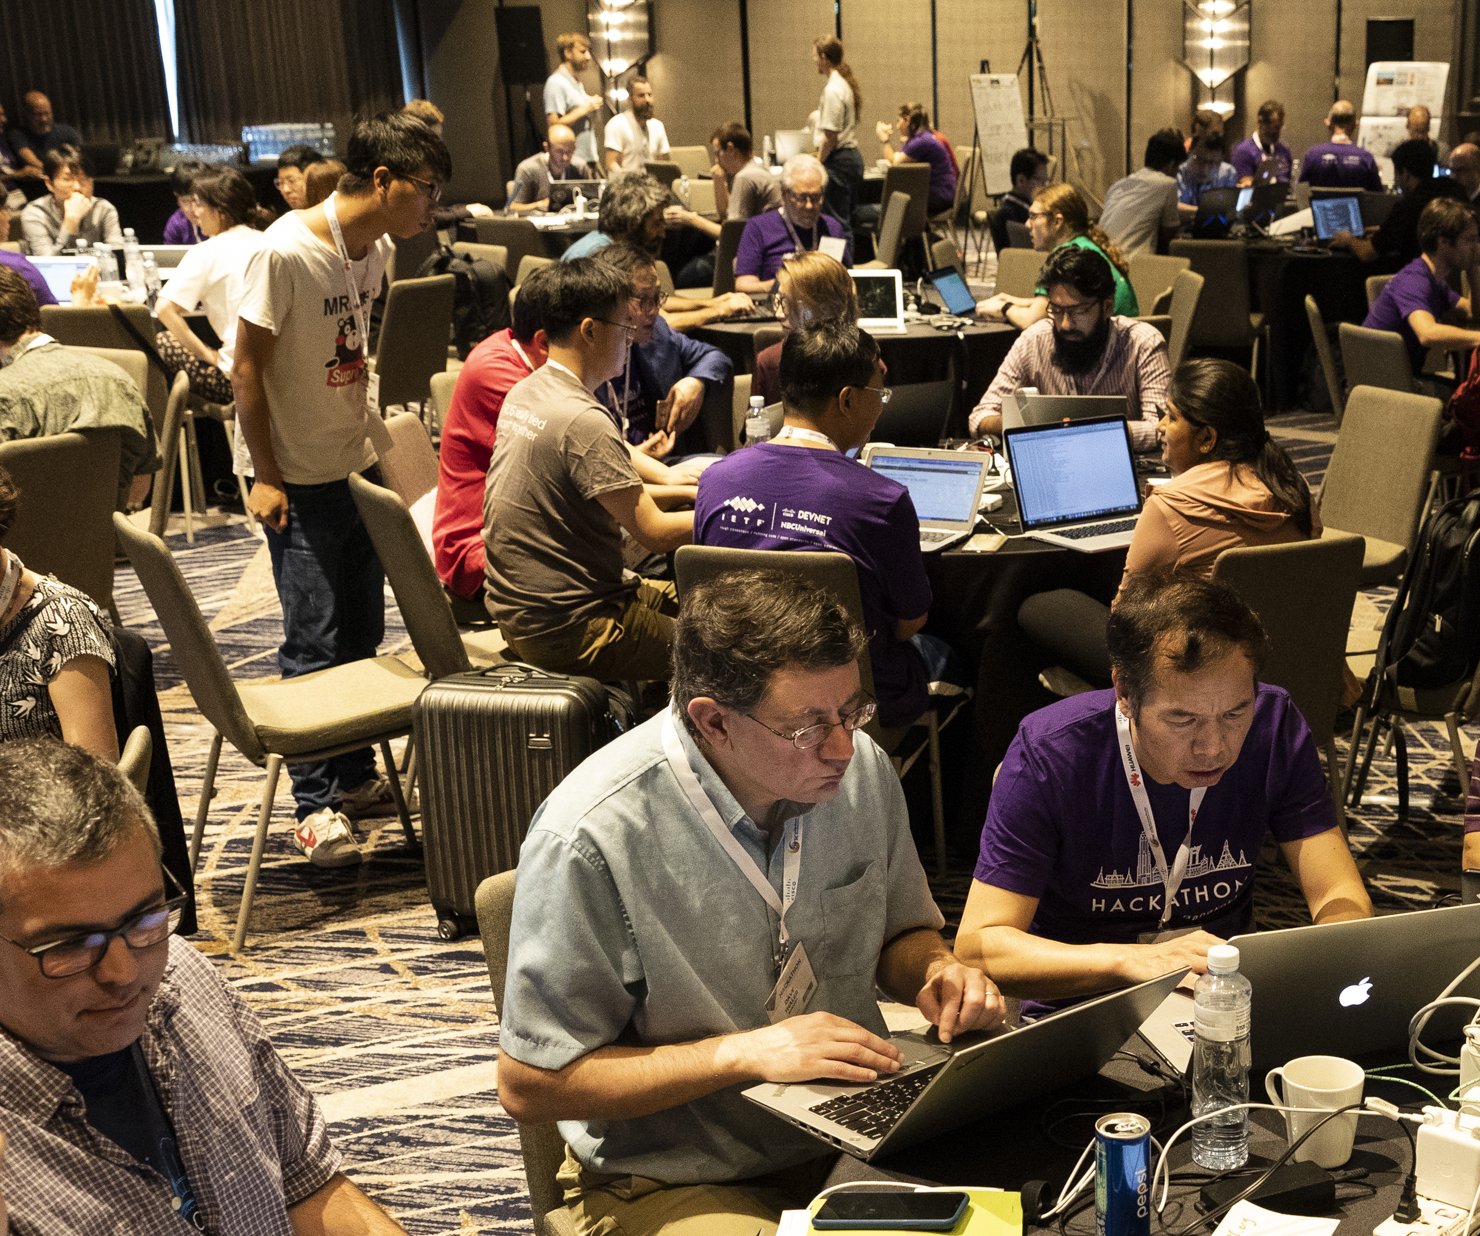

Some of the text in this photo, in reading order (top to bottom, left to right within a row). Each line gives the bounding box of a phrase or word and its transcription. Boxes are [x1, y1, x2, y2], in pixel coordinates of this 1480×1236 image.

[721, 513, 764, 527] IETF
[797, 510, 833, 526] DEVNET
[780, 521, 827, 537] NBCUniversal
[1125, 744, 1137, 772] HUAWEI
[1135, 1170, 1149, 1219] pepsi
